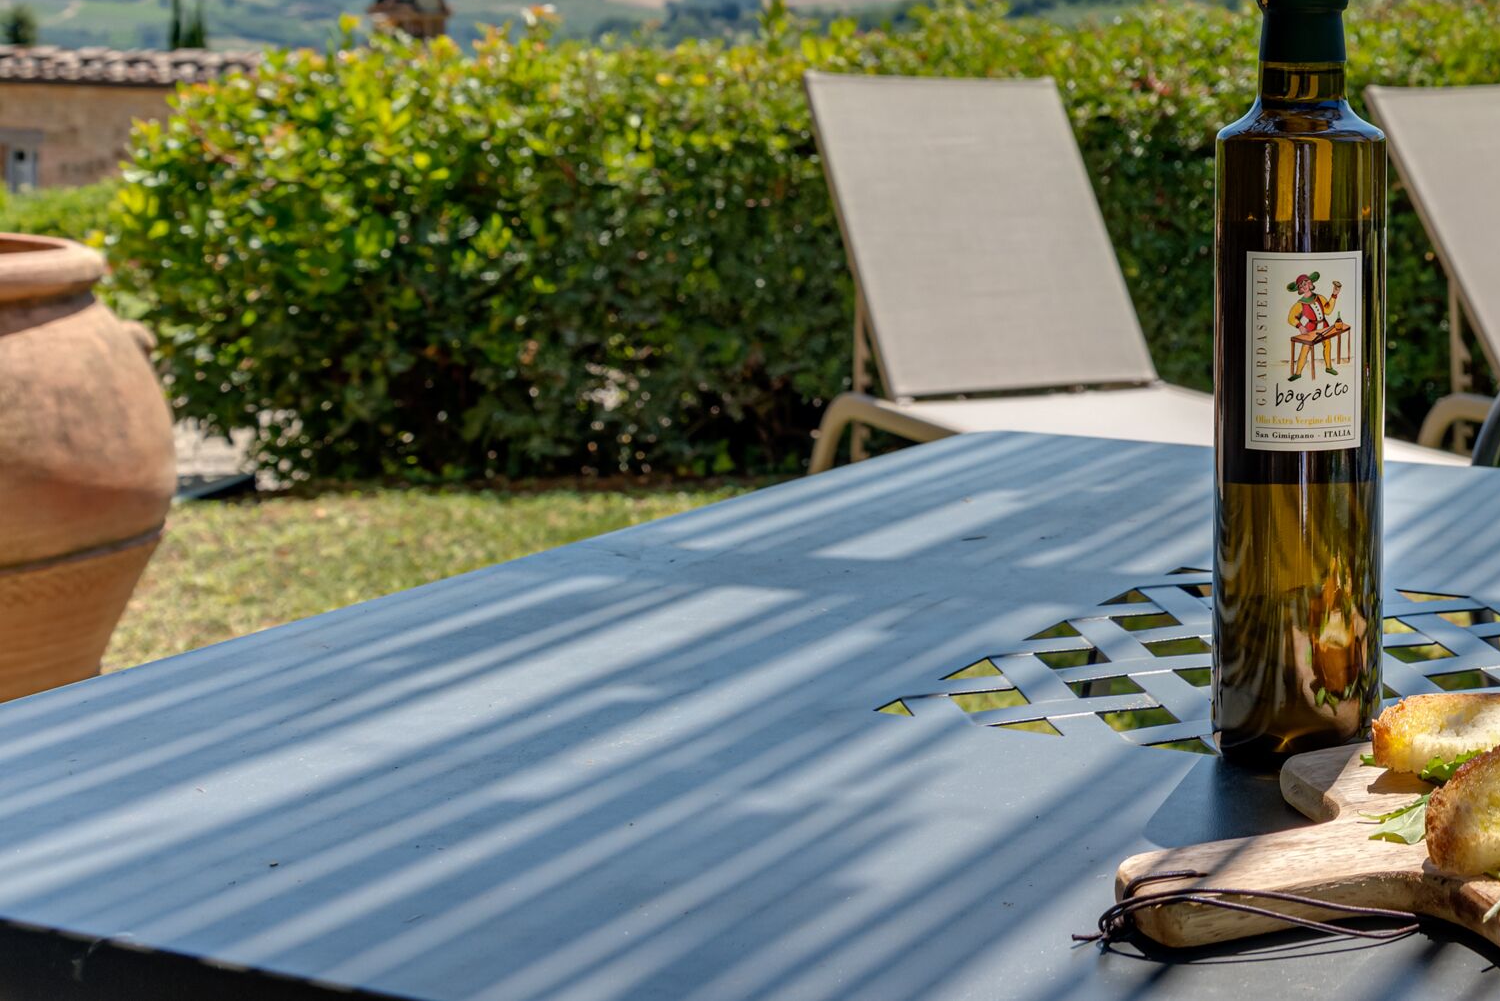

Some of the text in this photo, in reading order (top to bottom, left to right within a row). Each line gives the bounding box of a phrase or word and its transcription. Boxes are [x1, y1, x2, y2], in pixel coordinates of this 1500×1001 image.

[1256, 264, 1268, 406] GUARDASTELLE
[1275, 383, 1349, 411] bagatto
[1255, 414, 1271, 424] Olio
[1272, 415, 1293, 425] Extra
[1295, 415, 1324, 426] Vergine
[1325, 414, 1333, 424] di
[1255, 430, 1269, 438] San
[1272, 431, 1315, 441] Gimignano
[1324, 429, 1352, 439] ITALIA
